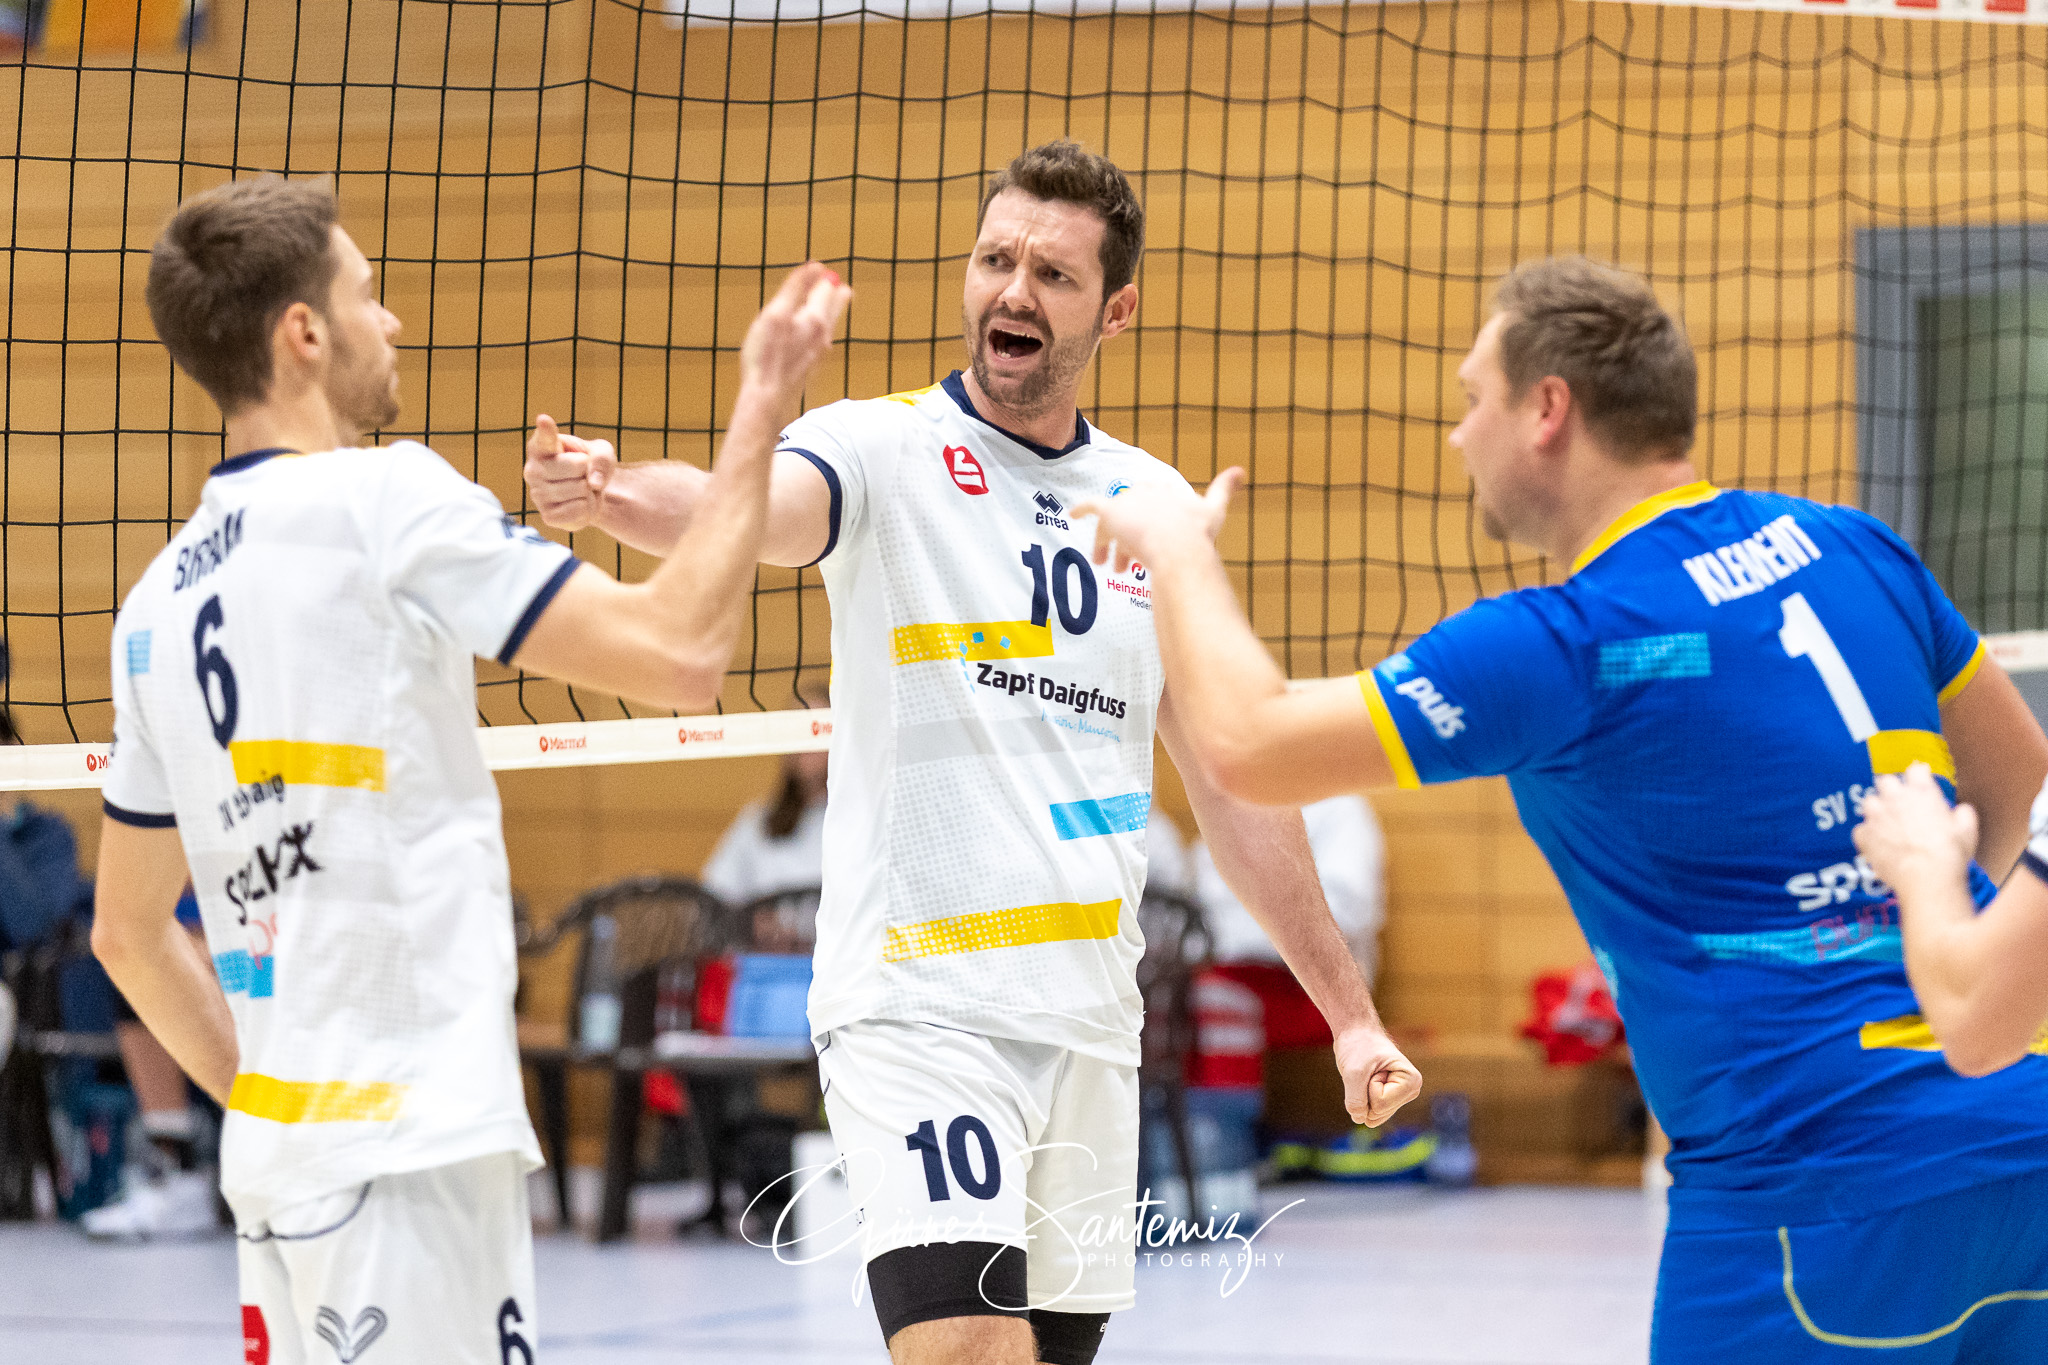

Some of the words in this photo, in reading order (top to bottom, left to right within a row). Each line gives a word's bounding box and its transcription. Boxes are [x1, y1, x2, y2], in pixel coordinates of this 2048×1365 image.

[1021, 543, 1098, 636] 10
[1682, 514, 1823, 607] KLEMENT
[193, 594, 239, 750] 6
[976, 662, 1035, 696] Zapf
[1039, 677, 1127, 719] Daigfuss
[1395, 676, 1466, 739] puls
[1777, 591, 1879, 743] 1
[1812, 790, 1847, 831] SV
[904, 1114, 1001, 1203] 10
